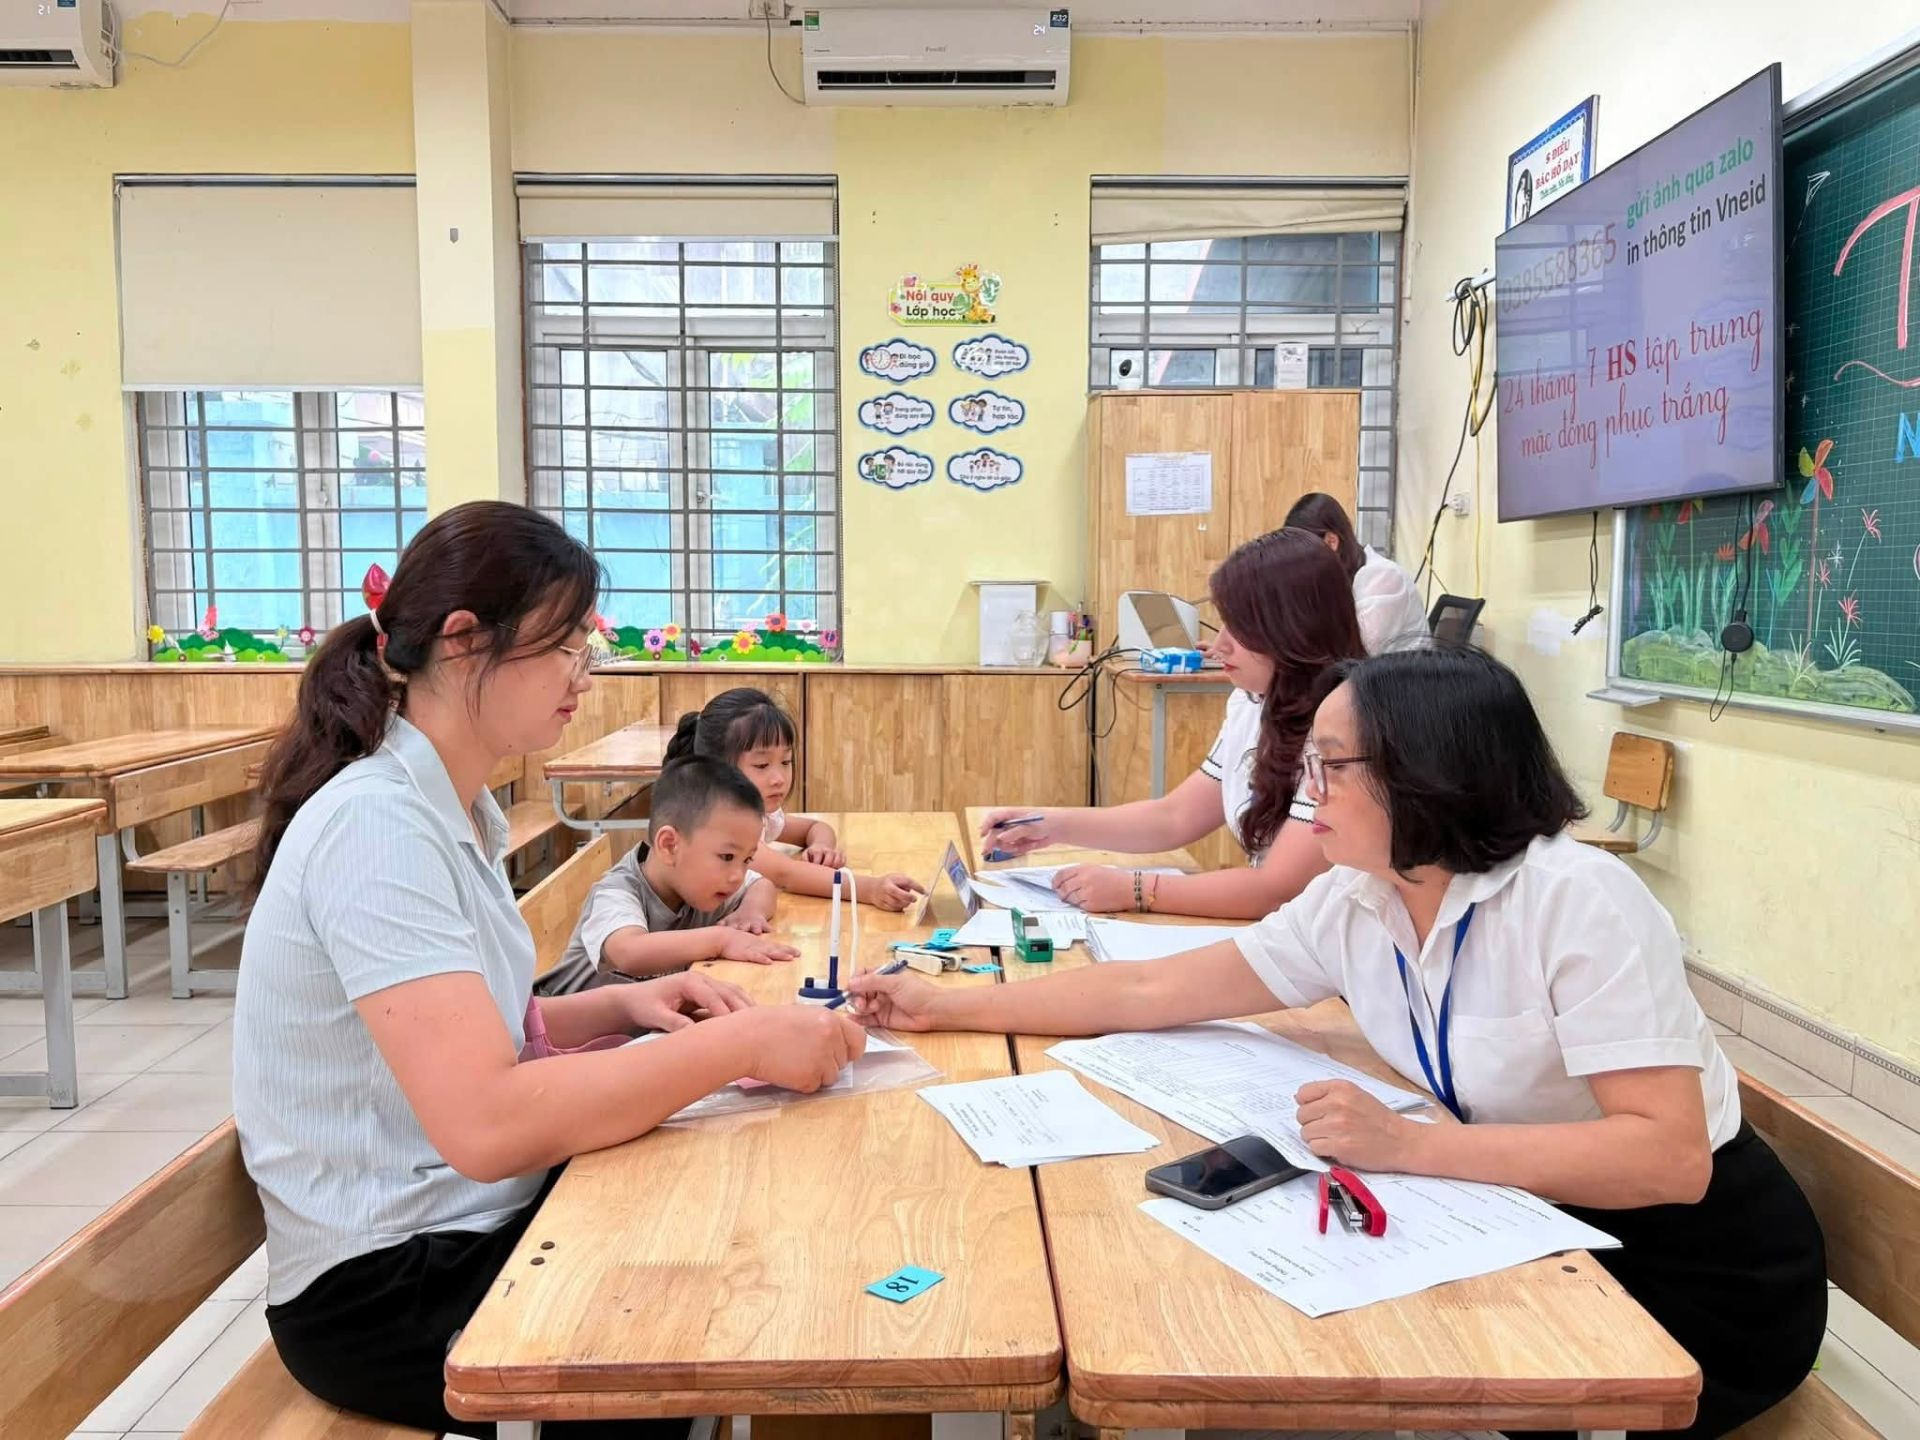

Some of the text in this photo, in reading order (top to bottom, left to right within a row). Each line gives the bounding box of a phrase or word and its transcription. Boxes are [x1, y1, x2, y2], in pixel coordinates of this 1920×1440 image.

[1535, 170, 1550, 190] BÁC
[1626, 190, 1650, 230] gửi
[1685, 160, 1715, 195] qua
[1718, 136, 1754, 175] zalo
[1627, 173, 1767, 266] in thông tin Vneid
[906, 289, 955, 304] Nội quy
[906, 304, 957, 320] Lớp học
[1504, 308, 1765, 421] 24 tháng 7 HS tập trung
[1605, 382, 1655, 458] phục
[1663, 381, 1730, 445] trắng
